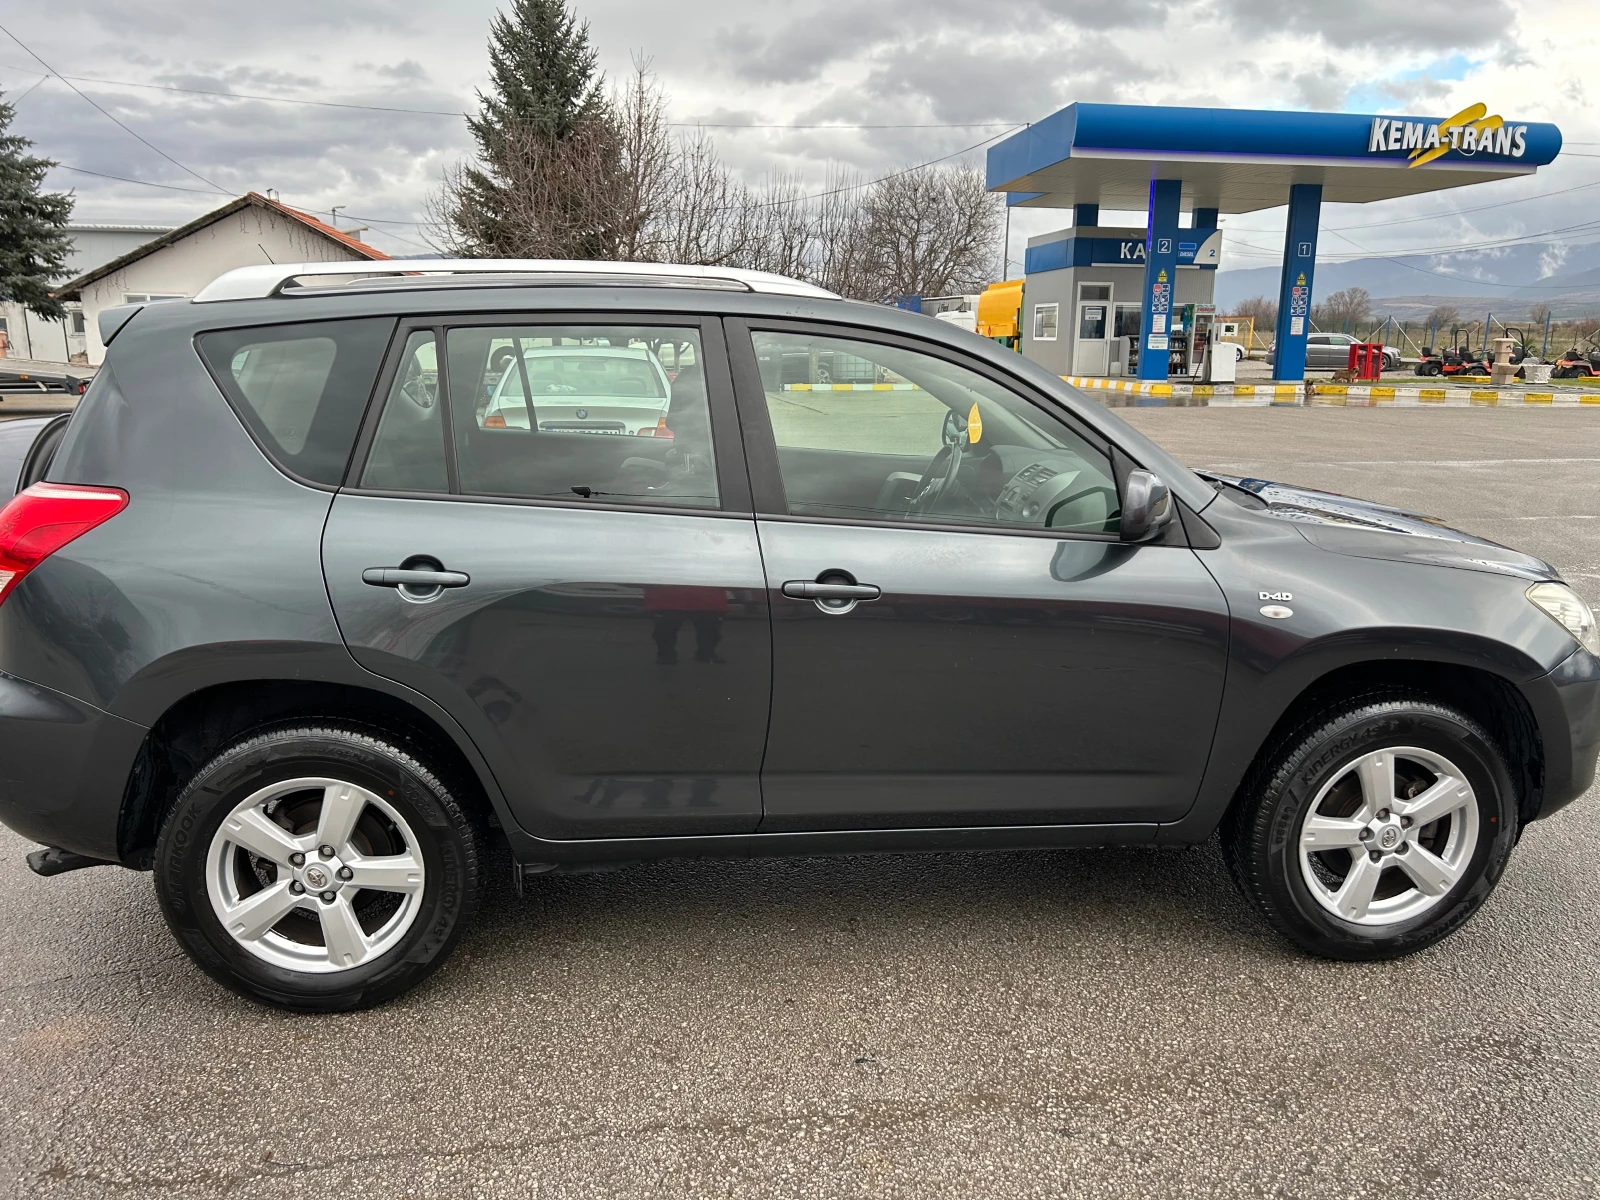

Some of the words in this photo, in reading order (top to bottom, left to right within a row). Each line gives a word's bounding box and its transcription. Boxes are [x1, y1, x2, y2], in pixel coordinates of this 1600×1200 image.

[1369, 117, 1527, 158] KEMA-TRANS
[1160, 240, 1168, 252] 2
[1209, 249, 1216, 257] 2
[1258, 591, 1293, 602] D-4D
[1301, 733, 1358, 785] KINERGY
